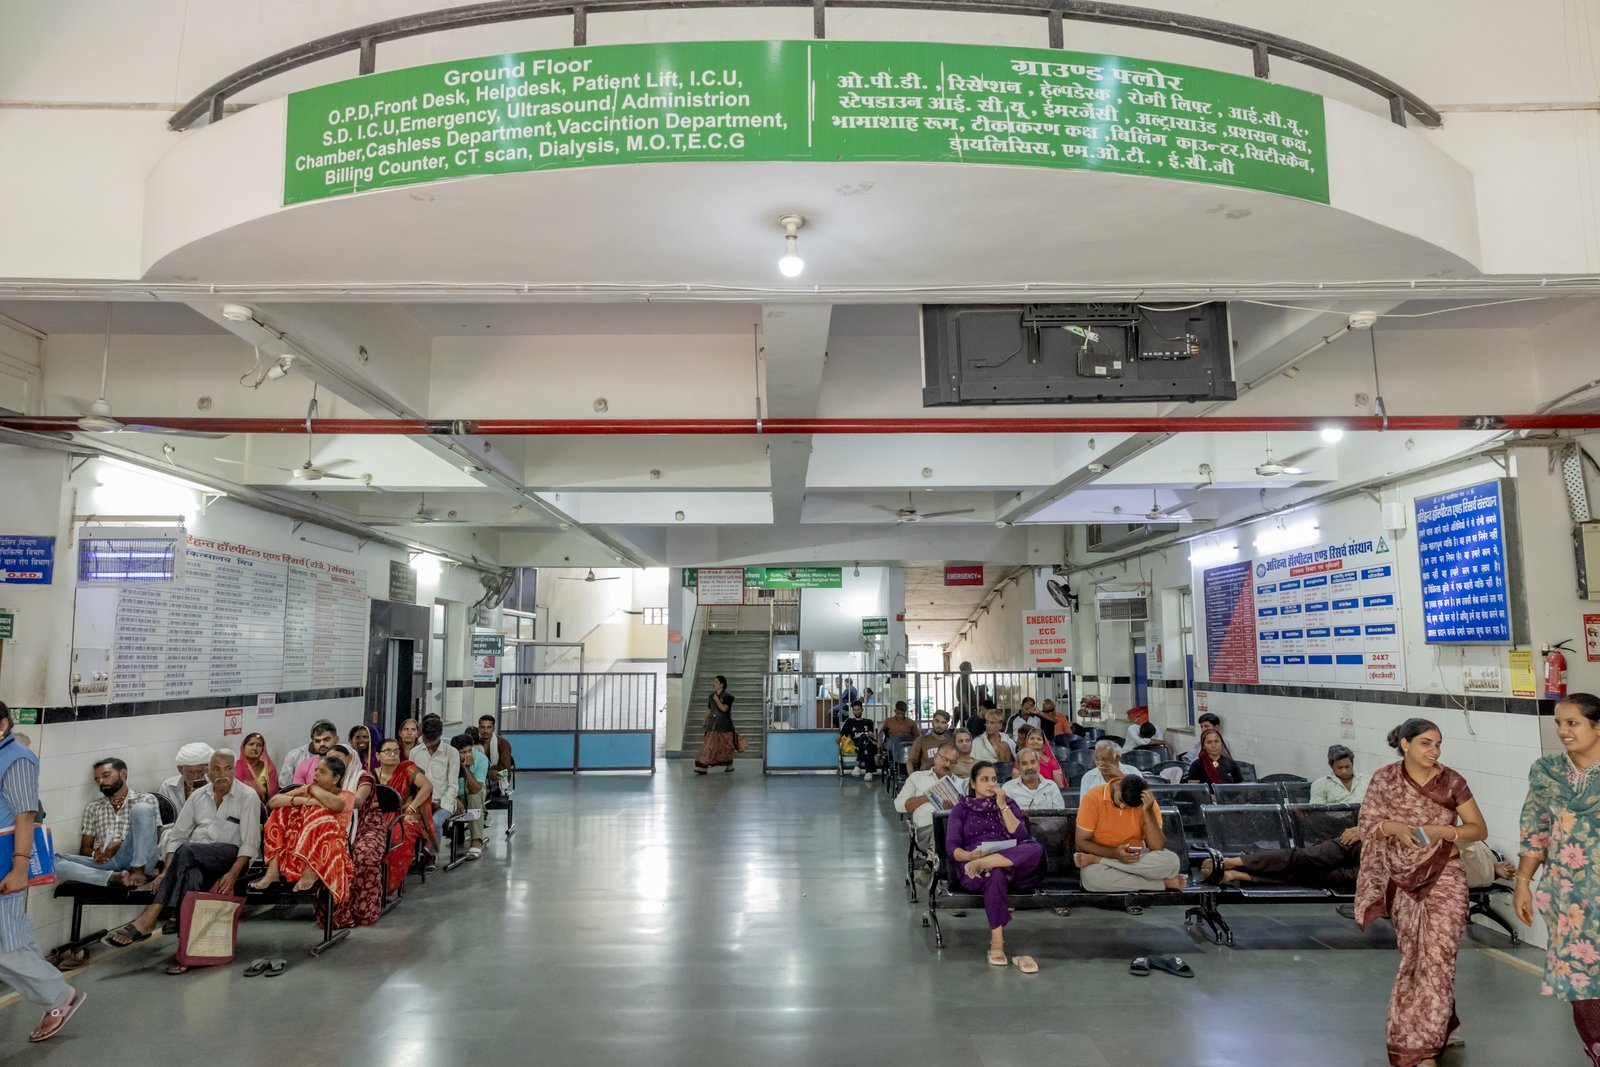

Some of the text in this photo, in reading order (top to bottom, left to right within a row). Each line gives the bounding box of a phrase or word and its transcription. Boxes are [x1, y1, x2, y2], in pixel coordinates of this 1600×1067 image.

[444, 59, 593, 87] Ground Floor
[1010, 60, 1105, 82] ग्राउण्ड
[328, 69, 744, 126] O.P.D,Front Desk, Helpdesk, Patient Lift, I.C.U,
[1128, 89, 1167, 108] रोगी
[322, 93, 750, 147] S.D. I.C.U,Emergency, Ultrasound, Administrion
[832, 115, 919, 132] भामाशाह
[295, 133, 442, 172] Chamber,Cashless
[666, 112, 788, 132] Department,
[324, 133, 746, 186] Billing Counter, CT scan, Dialysis, M.O.T,E.C.G
[1026, 616, 1066, 625] EMERGENCY
[1030, 638, 1066, 646] DRESSING
